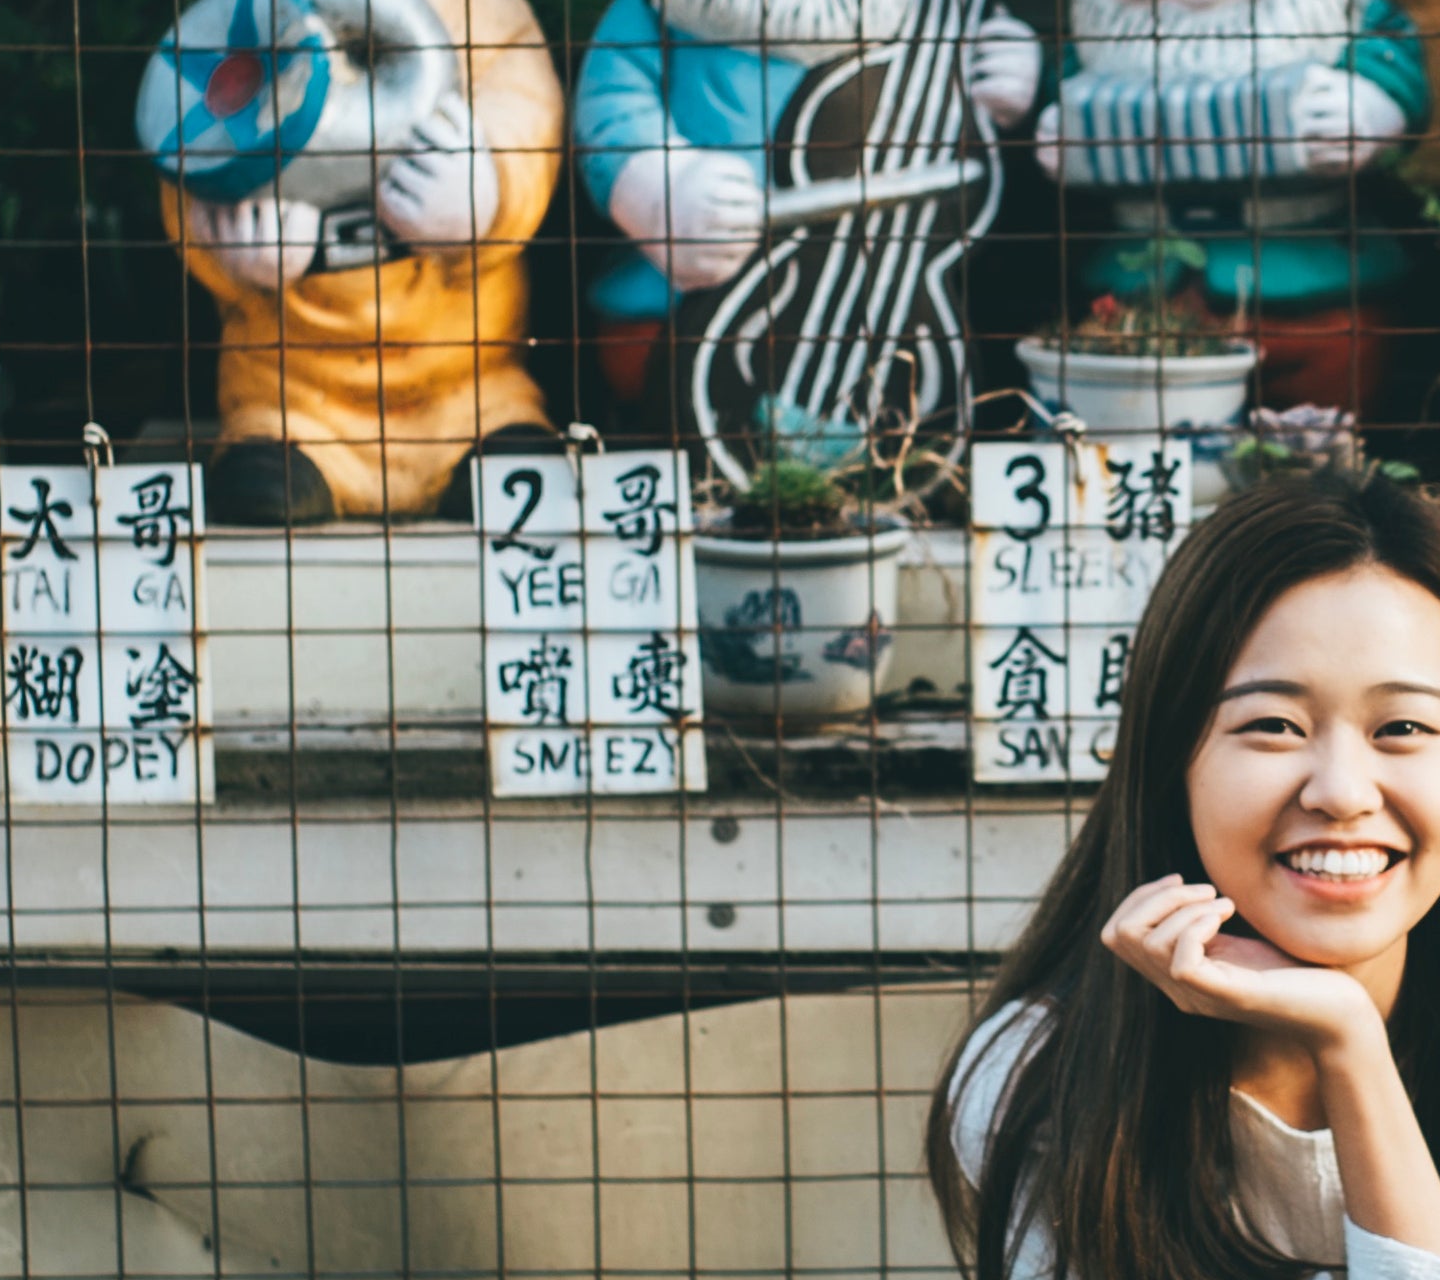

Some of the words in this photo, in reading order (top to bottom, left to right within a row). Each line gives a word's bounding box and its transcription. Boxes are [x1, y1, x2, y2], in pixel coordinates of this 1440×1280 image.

[8, 472, 192, 567] 大哥
[492, 464, 678, 560] 2哥
[3, 566, 72, 614] TAI
[132, 571, 187, 611] GA
[499, 563, 583, 614] YEE
[5, 642, 199, 730] 糊塗
[35, 730, 189, 787] DOPEY
[513, 729, 678, 779] SNEEZY
